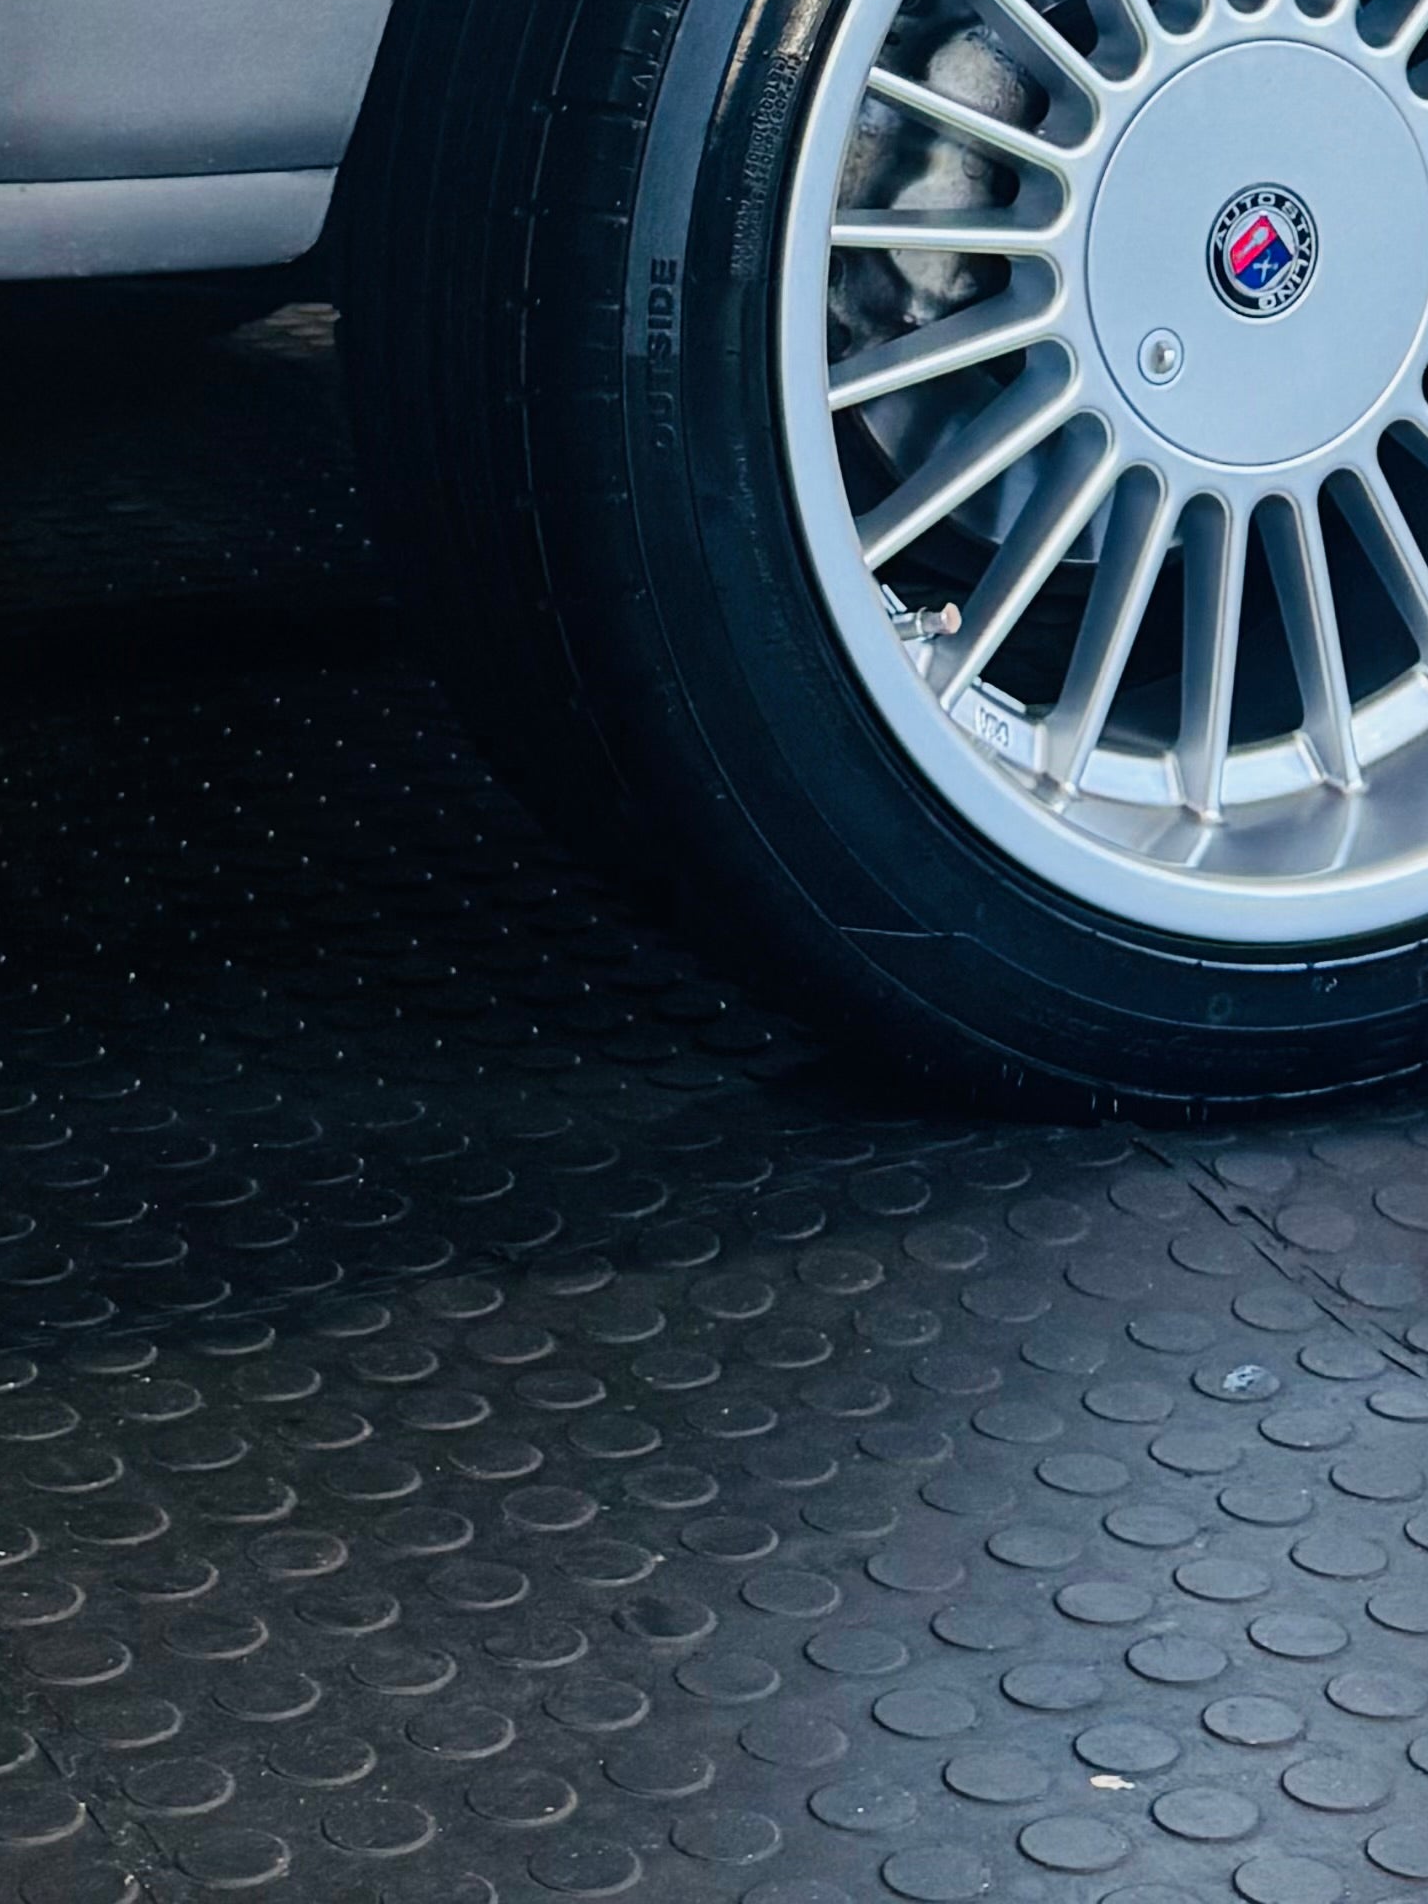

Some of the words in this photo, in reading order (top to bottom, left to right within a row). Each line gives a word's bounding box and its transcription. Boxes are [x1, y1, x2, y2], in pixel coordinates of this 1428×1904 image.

[1215, 192, 1276, 251] AUTO
[1258, 200, 1314, 311] STYLING
[647, 257, 678, 453] OUTSIDE
